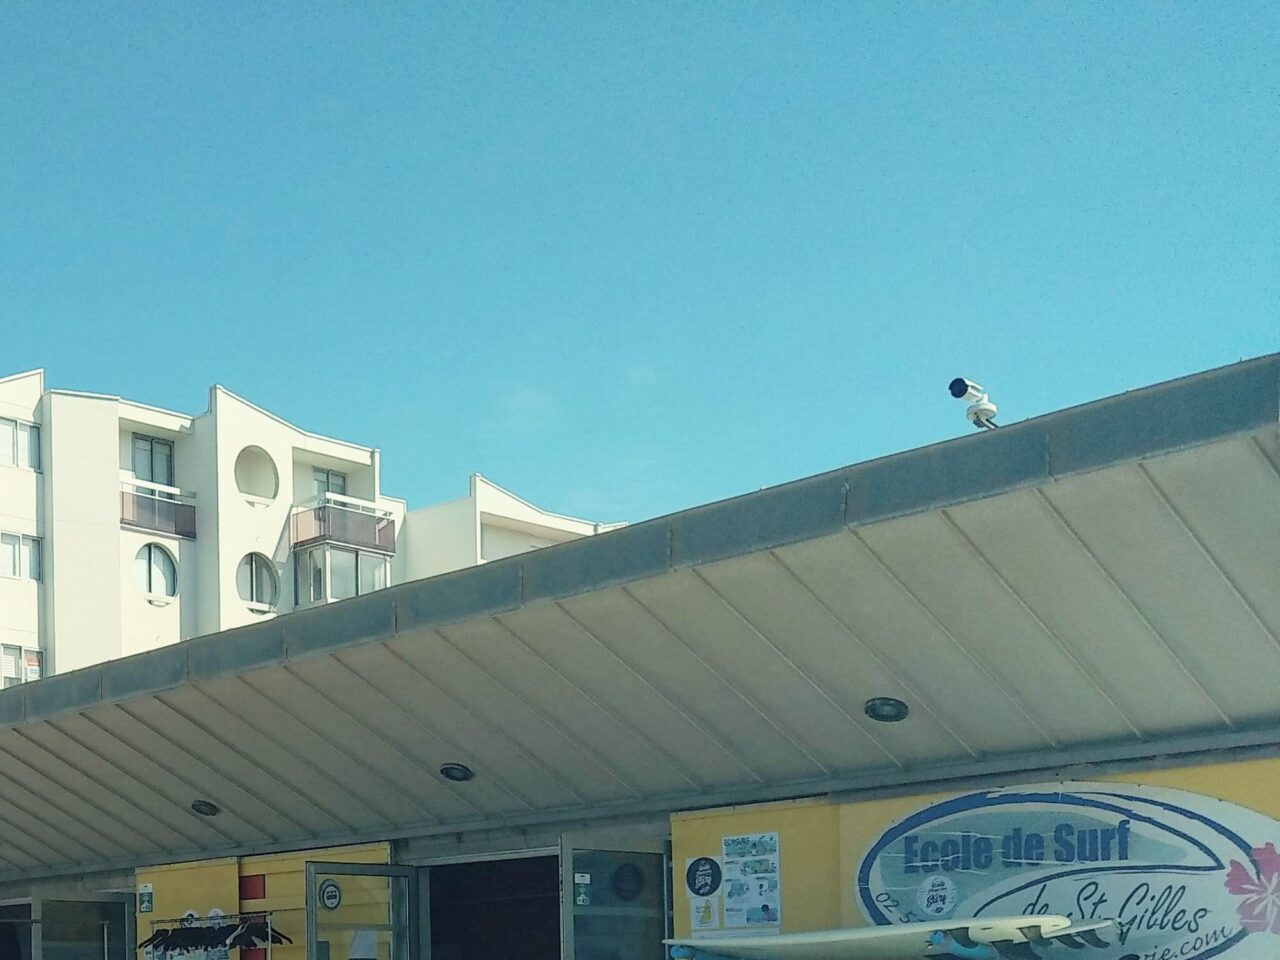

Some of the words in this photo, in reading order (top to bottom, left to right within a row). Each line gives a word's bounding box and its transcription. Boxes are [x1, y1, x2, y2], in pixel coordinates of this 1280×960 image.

[903, 831, 993, 874] Ecole
[1001, 827, 1045, 868] de
[1054, 819, 1131, 863] Surf
[876, 892, 900, 914] 02
[1022, 884, 1050, 916] de
[1110, 882, 1212, 933] Gilles
